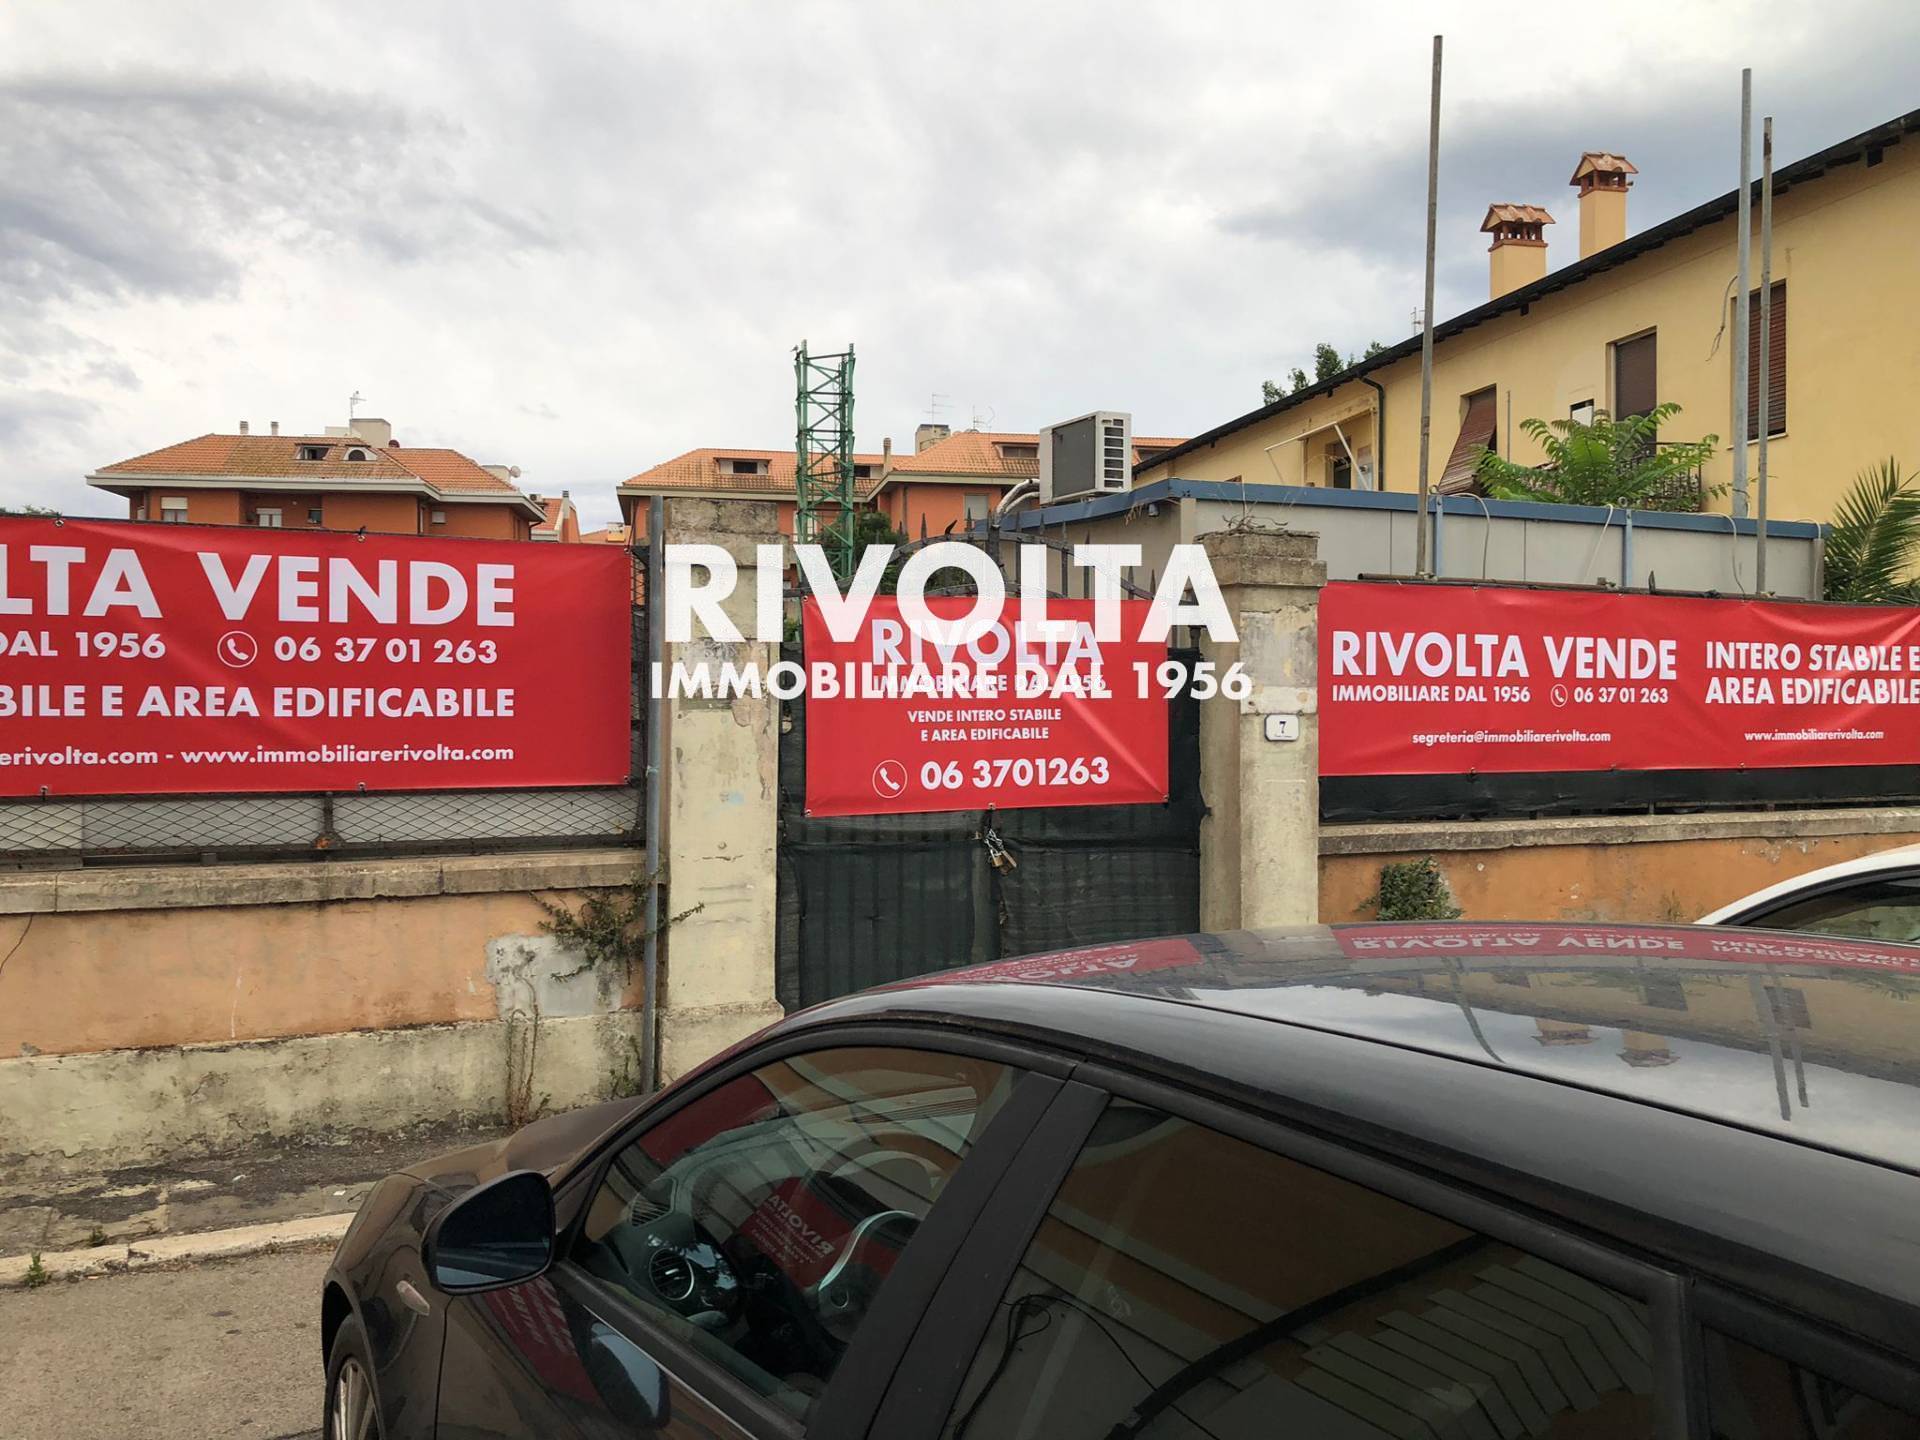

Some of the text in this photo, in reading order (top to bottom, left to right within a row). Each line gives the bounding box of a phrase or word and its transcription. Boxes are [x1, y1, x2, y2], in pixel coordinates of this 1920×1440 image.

[197, 552, 514, 627] VENDE
[75, 631, 166, 659] 1956
[274, 636, 498, 664] 06 37 01 263
[871, 619, 1104, 666] RIVOLTA
[1331, 630, 1677, 680] RIVOLTA VENDE
[1705, 640, 1920, 672] INTERO STABILE E
[102, 685, 123, 717] E
[137, 685, 260, 717] AREA
[273, 687, 515, 718] EDIFICABILE
[1332, 685, 1531, 703] IMMOBILIARE DAL 1956
[1574, 687, 1668, 704] 06 37 01 263
[1705, 676, 1920, 705] AREA EDIFICABILE
[907, 708, 1062, 723] VENDE INTERO STABILE
[1279, 720, 1287, 734] 7
[920, 727, 1049, 741] E AREA EDIFICABILE
[1412, 729, 1611, 746] segreteria@immobiliarerivolta.com
[1744, 729, 1884, 741] www.immobiliarerivolta.com
[180, 744, 515, 763] www.immobiliarerivolta.com
[920, 756, 1110, 790] 06 3701263
